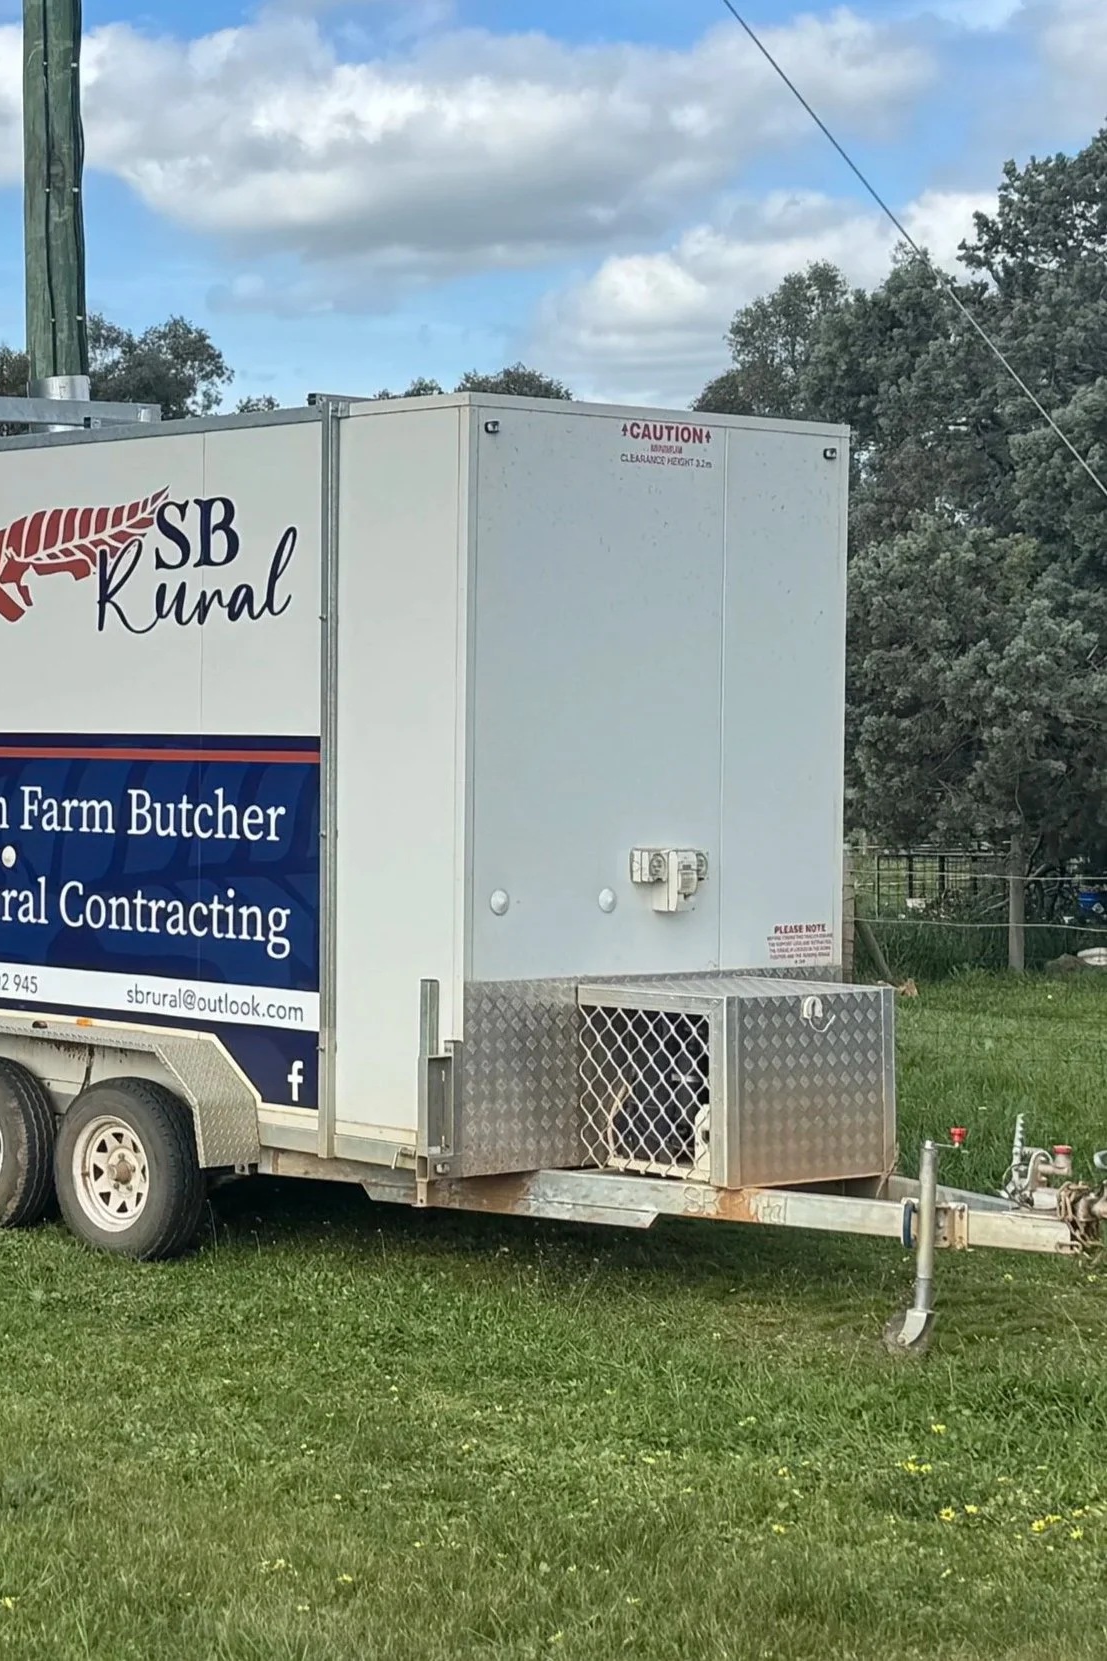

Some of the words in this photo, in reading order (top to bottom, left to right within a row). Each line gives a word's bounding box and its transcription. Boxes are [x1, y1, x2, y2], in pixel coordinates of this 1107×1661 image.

[630, 422, 703, 444] CAUTION
[620, 453, 665, 466] CLEARANCE
[667, 457, 694, 468] HEIGHT
[155, 496, 240, 570] SB
[97, 526, 298, 634] Rural
[19, 785, 116, 834] Farm
[127, 787, 287, 841] Butcher
[59, 880, 291, 959] Contracting
[774, 924, 804, 934] PLEASE
[805, 923, 826, 933] NOTE
[13, 974, 38, 994] 945
[126, 984, 304, 1022] sbrural@outlook.com
[287, 1059, 304, 1102] f
